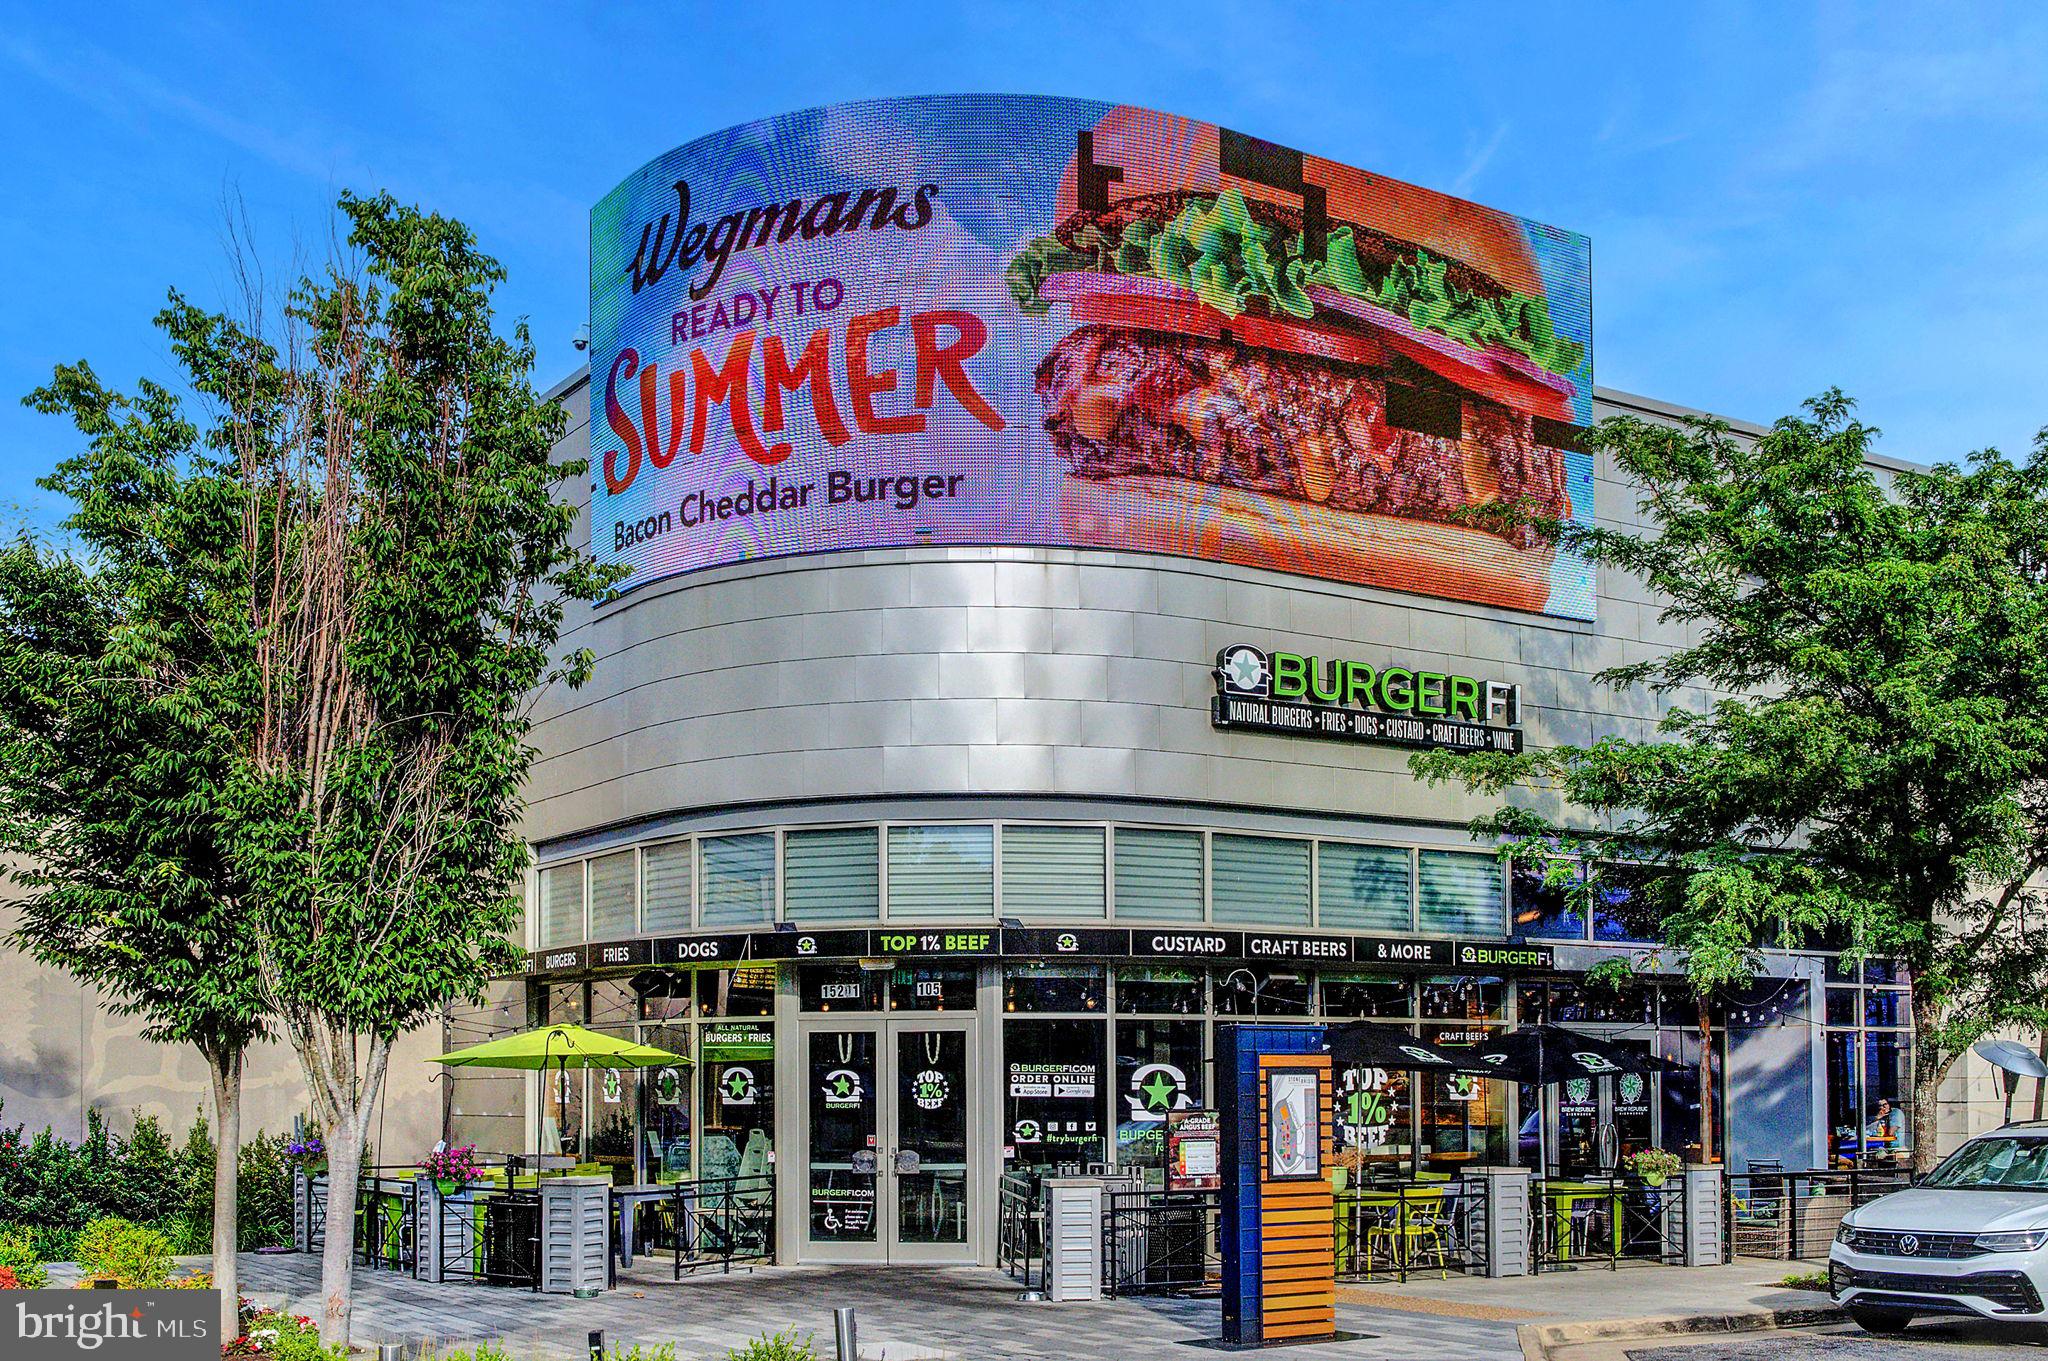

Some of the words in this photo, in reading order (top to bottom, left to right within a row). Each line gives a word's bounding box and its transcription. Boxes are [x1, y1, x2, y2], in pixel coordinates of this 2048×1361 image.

[625, 180, 939, 300] Wegmans
[671, 286, 781, 346] READY
[789, 277, 844, 316] TO
[603, 305, 1005, 497] SUMMER
[615, 511, 671, 552] Bacon
[680, 477, 814, 528] Cheddar
[828, 470, 964, 509] Burger
[1272, 651, 1522, 725] BURGERFI
[1229, 701, 1270, 723] NATURAL
[1272, 706, 1312, 728] BURGERS
[1321, 711, 1346, 732] FRIES
[1355, 716, 1377, 735] DOGS
[1386, 719, 1424, 740] CUSTARD
[1432, 725, 1458, 744] CRAFT
[1460, 727, 1485, 747] BEERS
[1493, 732, 1514, 750] WINE
[678, 941, 718, 959] DOGS
[880, 934, 917, 952] TOP
[919, 934, 941, 951] 1%
[945, 933, 990, 951] BEEF
[1151, 935, 1226, 954] CUSTARD
[1251, 938, 1299, 956] CRAFT
[1302, 939, 1347, 957] BEERS
[603, 947, 629, 962] FRIES
[1377, 943, 1390, 959] &
[1391, 943, 1431, 960] MORE
[1478, 949, 1552, 965] BURGERFI
[545, 952, 577, 969] BURGERS
[918, 983, 939, 996] 105
[706, 1033, 742, 1042] BURGERS
[748, 1033, 771, 1042] FRIES
[1439, 1032, 1463, 1041] CRAFT
[1465, 1032, 1489, 1041] BEERS
[917, 1070, 944, 1083] TOP
[1021, 1064, 1095, 1073] BURGERFI.COM
[1011, 1075, 1048, 1083] ORDER
[1053, 1075, 1096, 1084] ONLINE
[1343, 1068, 1388, 1091] TOP
[920, 1083, 942, 1098] 1%
[916, 1098, 944, 1109] BEEF
[1347, 1092, 1387, 1124] 1%
[1046, 1134, 1098, 1145] #tryburgerfi
[1343, 1125, 1389, 1148] BEEF
[812, 1188, 874, 1197] BURGERFI.COM
